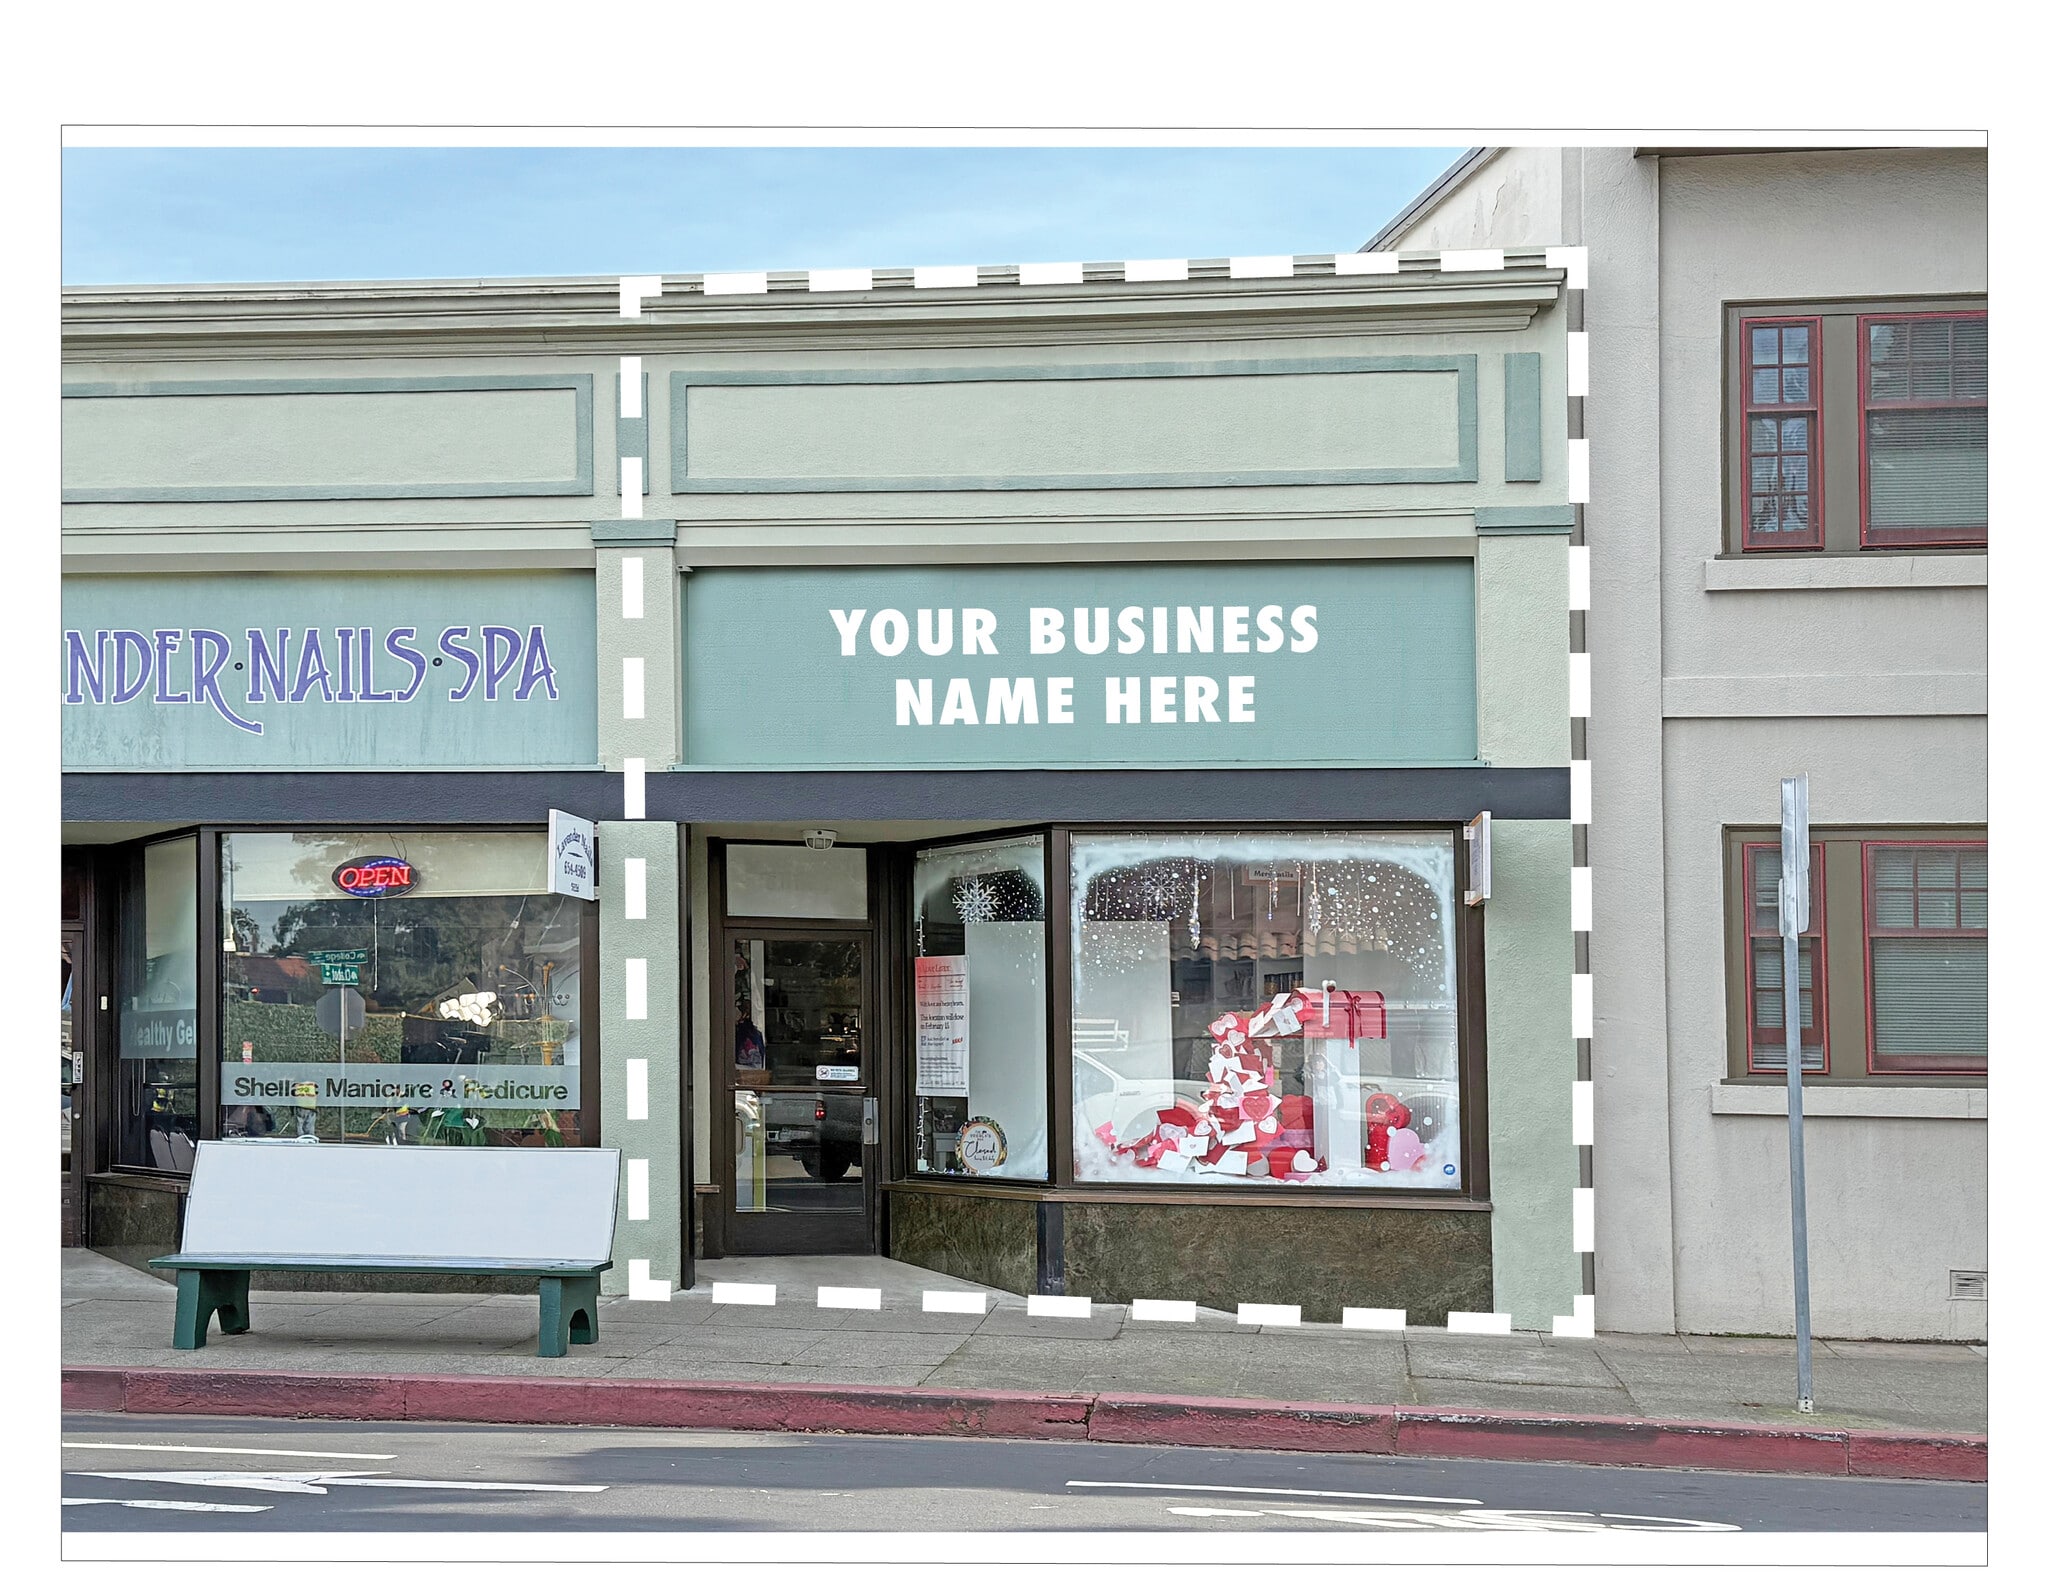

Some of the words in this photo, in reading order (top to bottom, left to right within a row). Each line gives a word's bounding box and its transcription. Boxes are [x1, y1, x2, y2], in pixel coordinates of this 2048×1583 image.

[61, 629, 263, 736] NDER
[246, 627, 428, 703] NAILS
[438, 625, 560, 702] SPA
[338, 866, 411, 888] OPEN
[326, 1078, 433, 1098] Manicure
[440, 1079, 457, 1099] &
[463, 1079, 568, 1099] Pedicure
